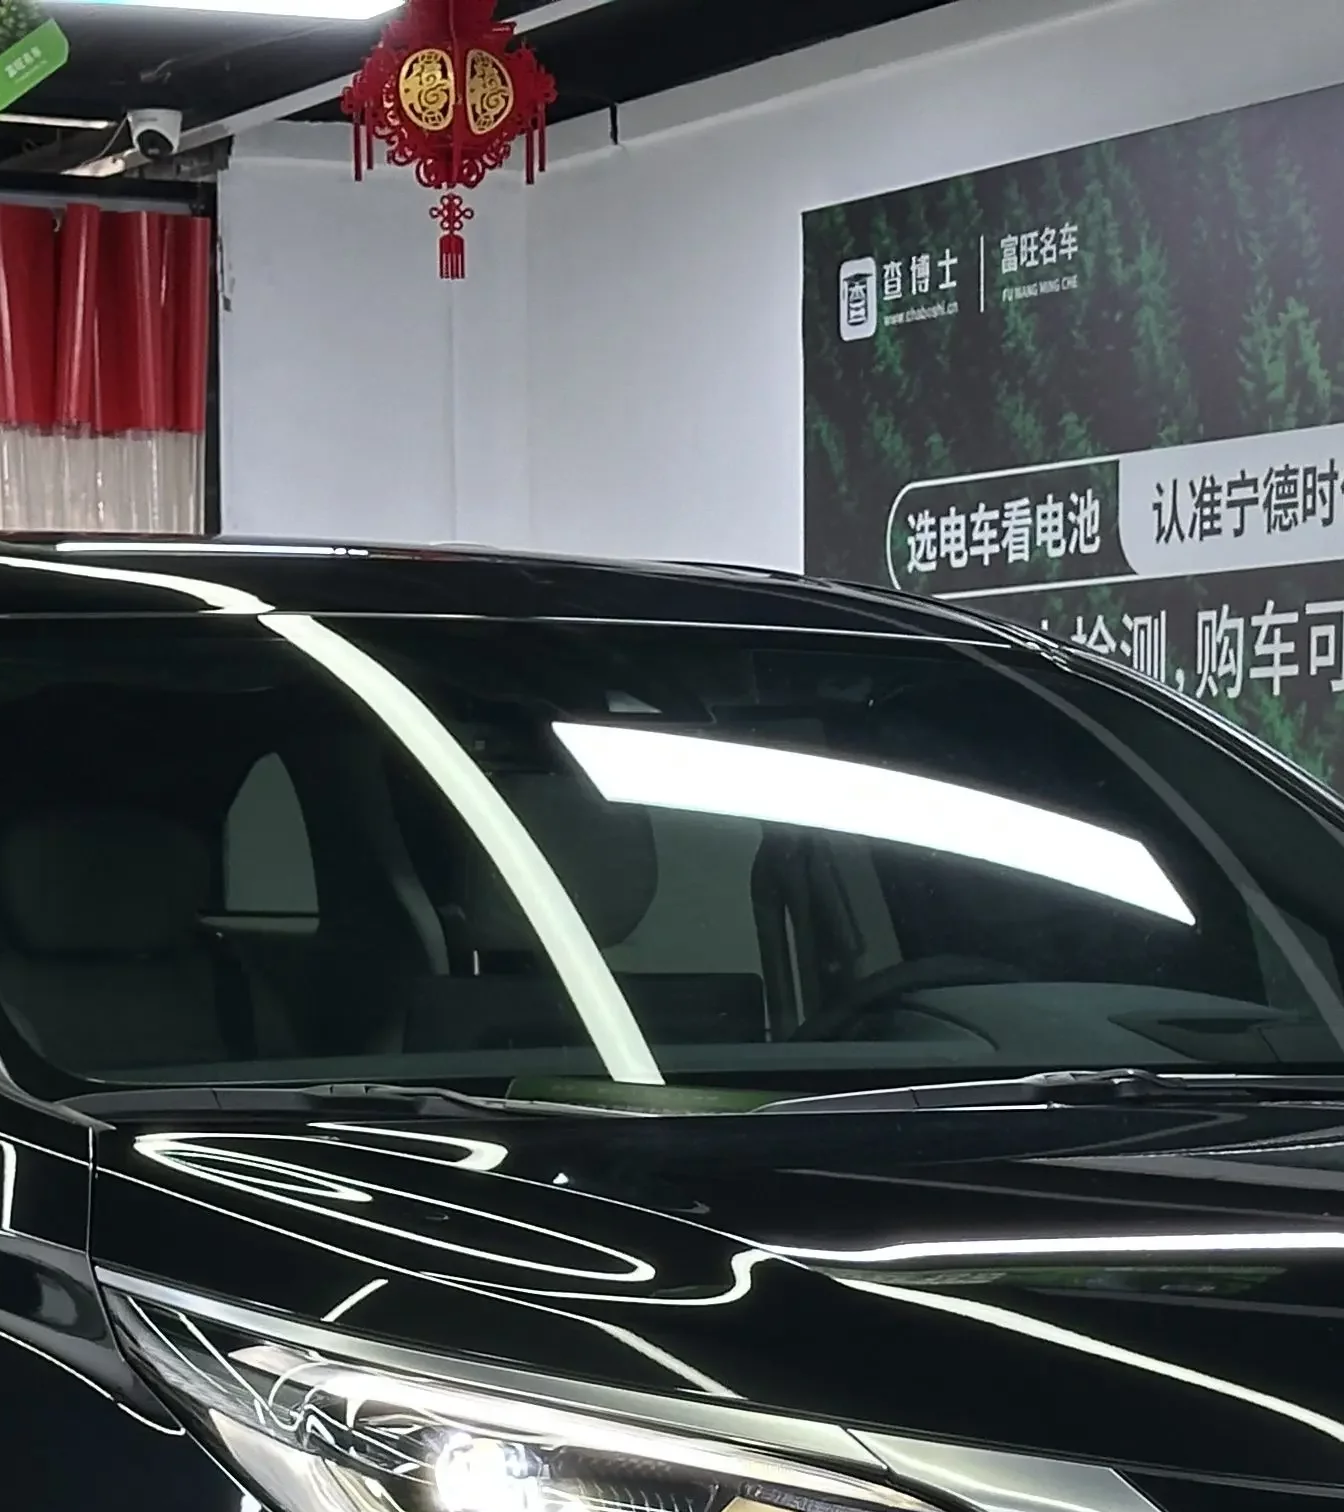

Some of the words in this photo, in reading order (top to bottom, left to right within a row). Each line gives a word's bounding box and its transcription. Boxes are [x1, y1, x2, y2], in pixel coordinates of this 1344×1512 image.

[882, 248, 958, 301] 查博士
[1000, 221, 1079, 275] 富旺名车
[906, 487, 1101, 574] 选电车看电池
